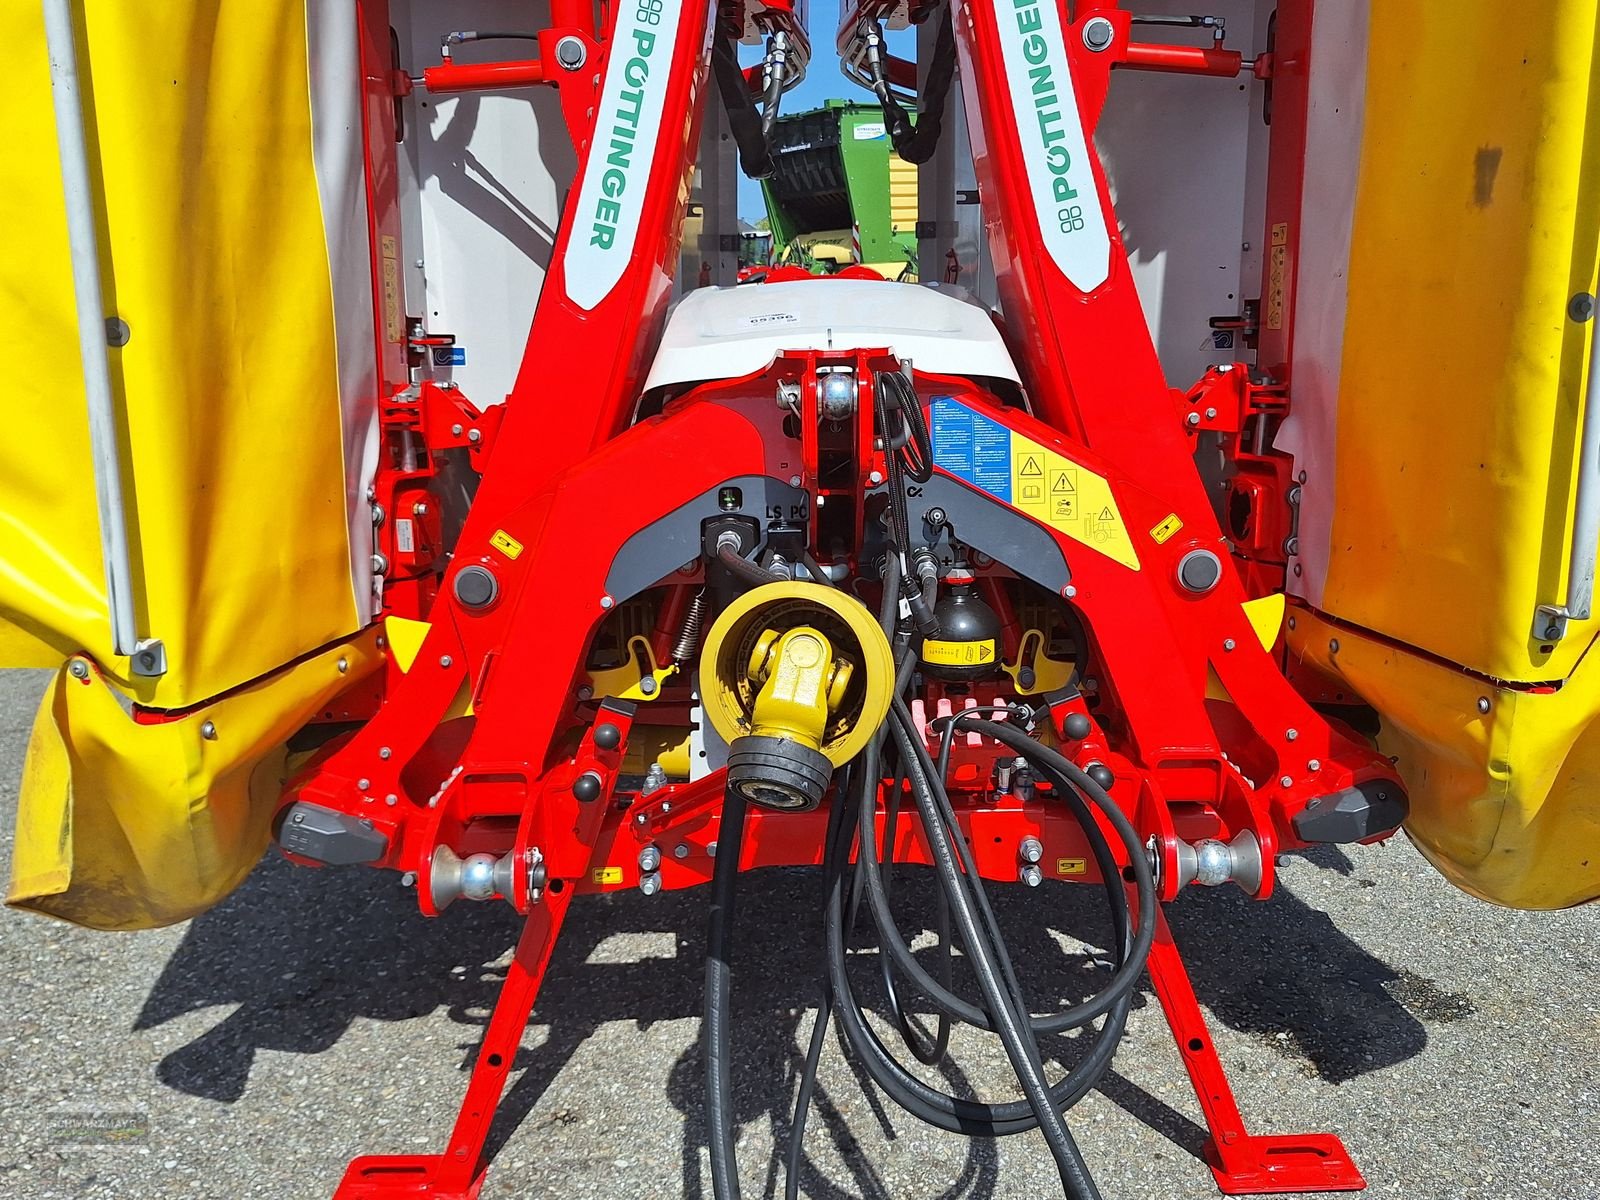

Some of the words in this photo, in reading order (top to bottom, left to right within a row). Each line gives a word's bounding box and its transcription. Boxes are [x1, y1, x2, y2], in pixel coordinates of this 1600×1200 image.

[589, 28, 656, 251] PÖTTINGER
[1012, 0, 1078, 203] PÖTTINGE
[765, 505, 782, 519] LS
